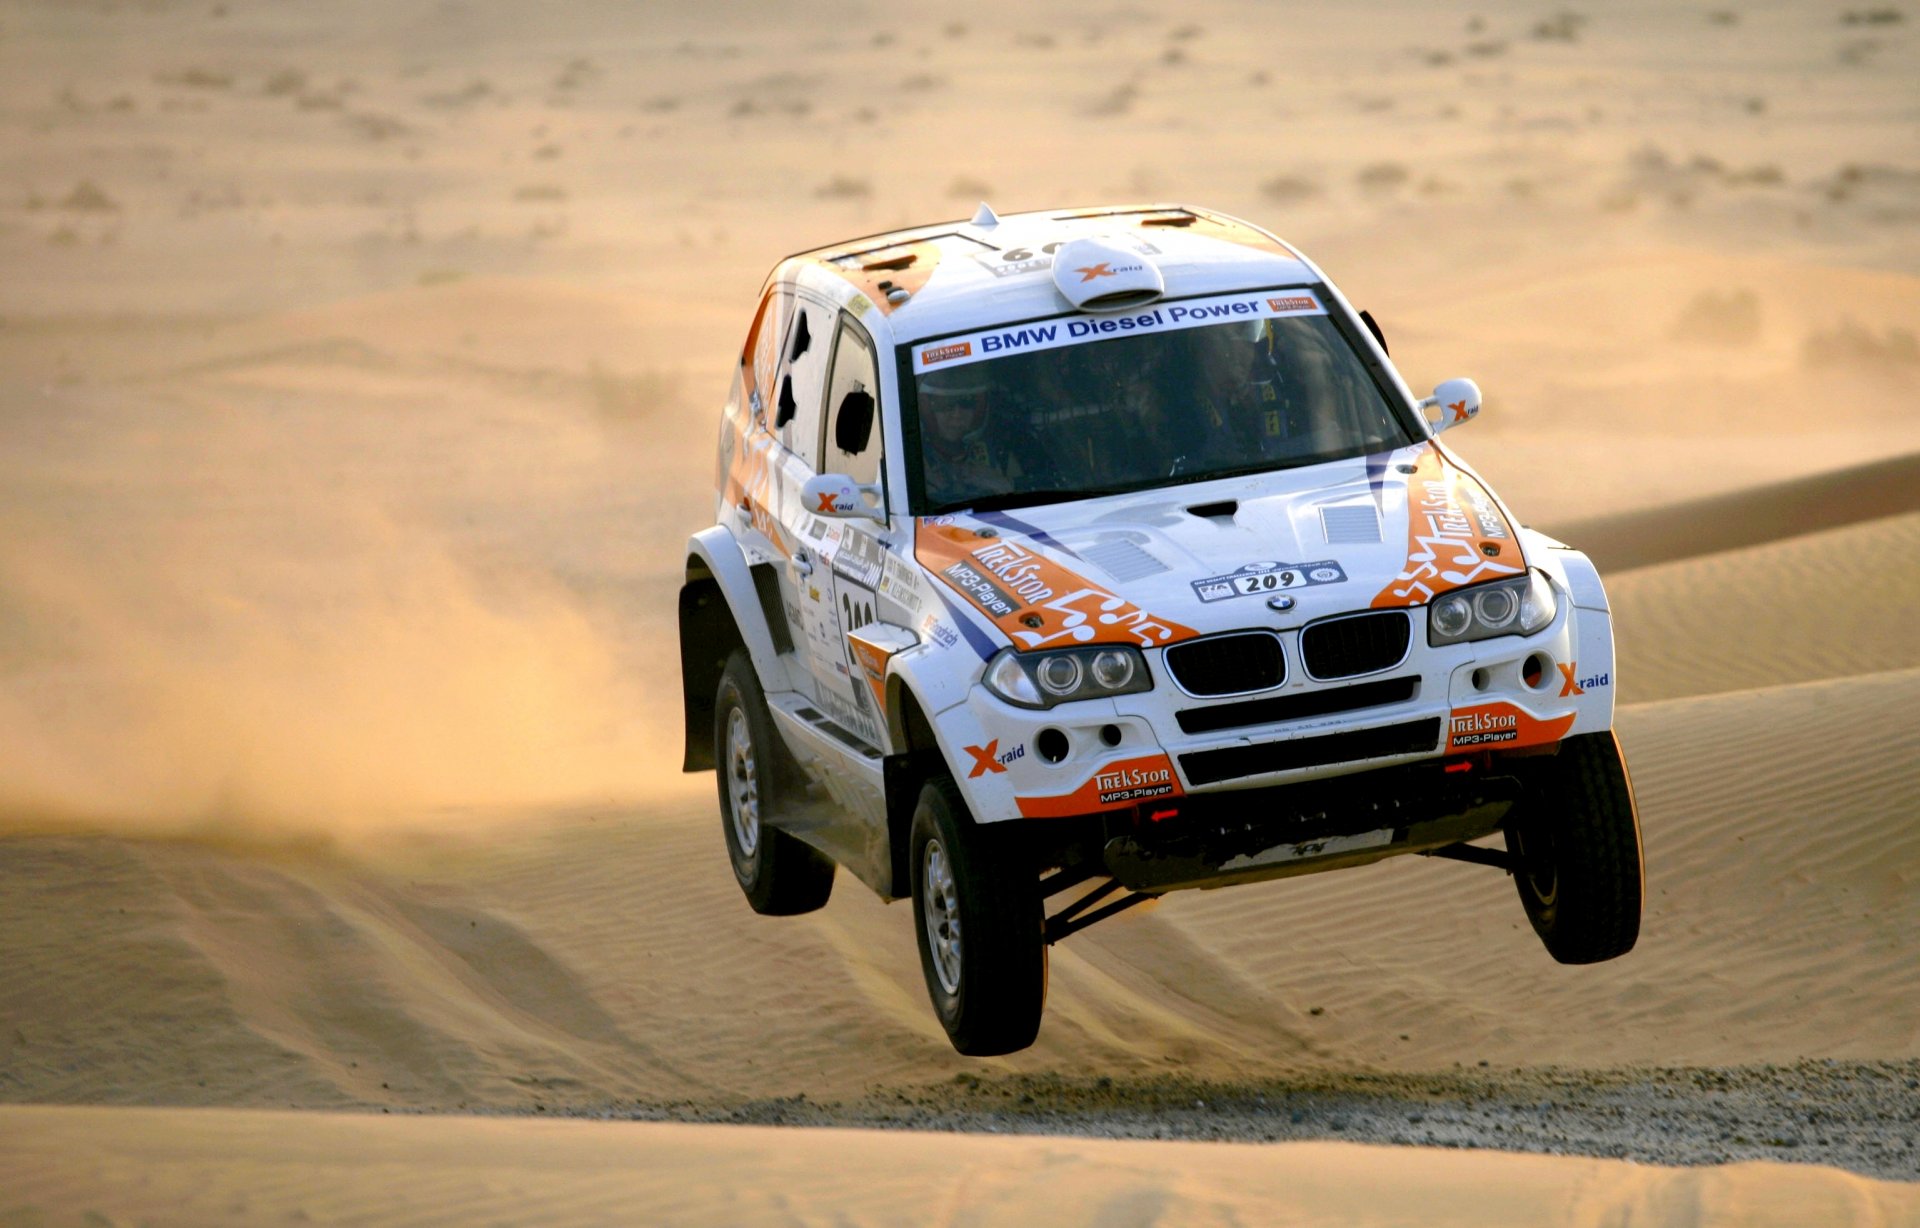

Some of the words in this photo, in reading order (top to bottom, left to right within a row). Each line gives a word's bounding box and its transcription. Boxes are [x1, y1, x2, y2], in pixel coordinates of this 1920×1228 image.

[981, 325, 1057, 353] BMW
[1067, 309, 1163, 337] Diesel
[1169, 301, 1259, 322] Power
[945, 562, 1011, 616] MP3-Player
[1245, 571, 1295, 593] 209
[1453, 730, 1517, 746] MP3-Player
[963, 738, 1025, 779] X-raid
[1100, 785, 1172, 803] MP3-Player
